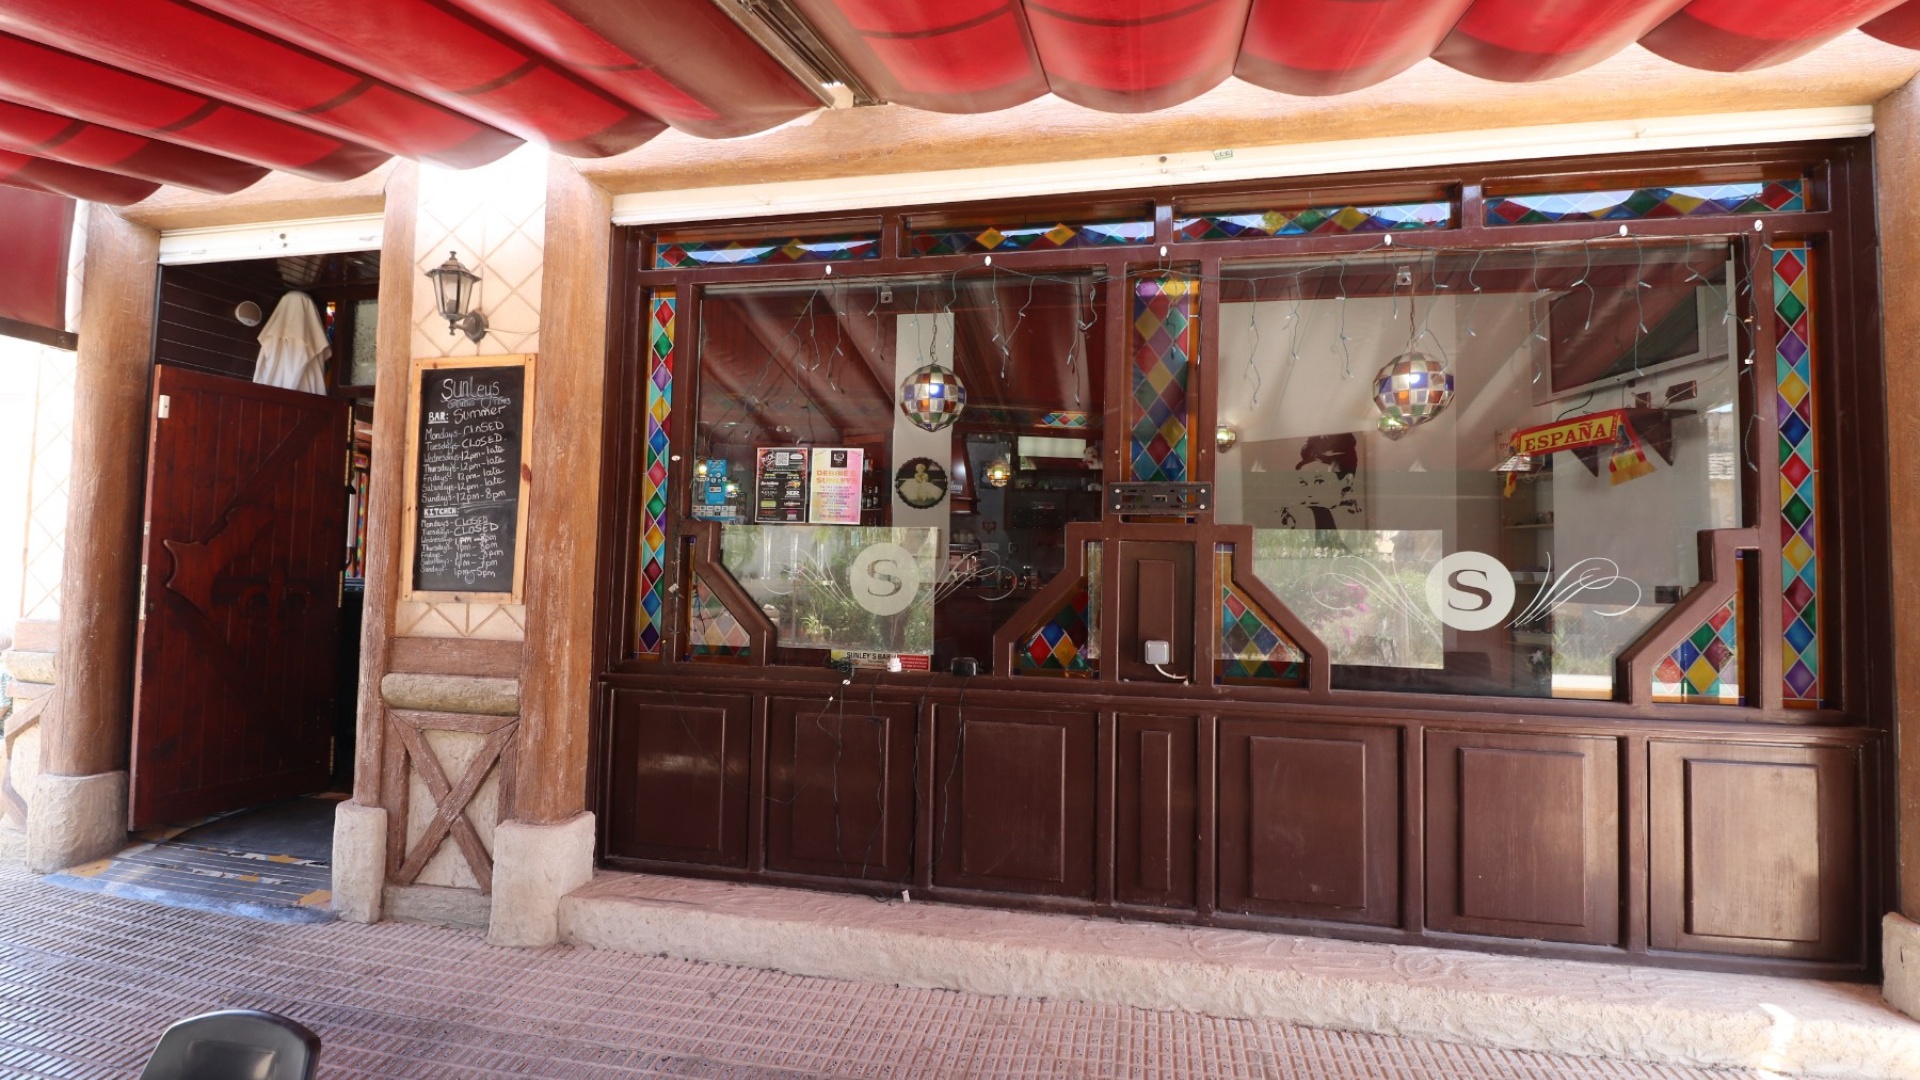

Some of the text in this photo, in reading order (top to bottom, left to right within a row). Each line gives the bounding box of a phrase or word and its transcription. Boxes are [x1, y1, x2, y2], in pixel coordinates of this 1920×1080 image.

[453, 405, 506, 424] Summer
[1525, 421, 1607, 452] ESPAÑA
[866, 559, 902, 597] S
[1447, 569, 1493, 612] S
